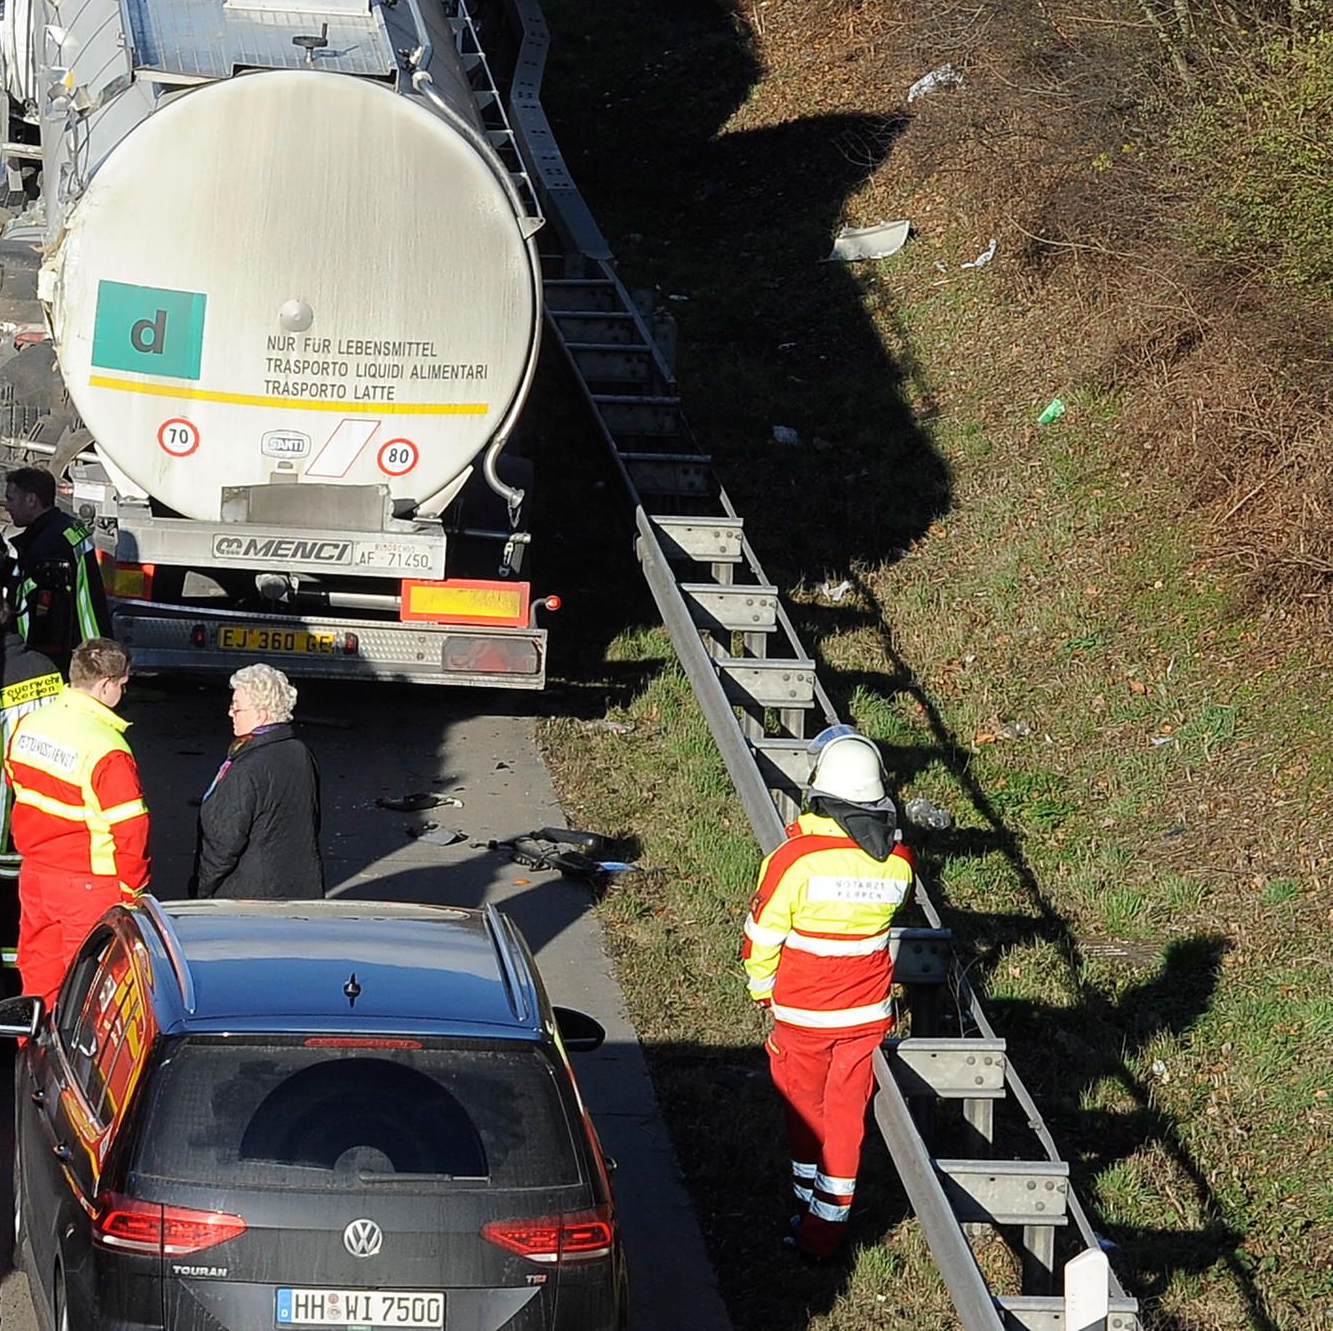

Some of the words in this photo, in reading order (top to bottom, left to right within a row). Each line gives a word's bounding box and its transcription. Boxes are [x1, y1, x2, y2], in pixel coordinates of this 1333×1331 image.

[130, 310, 168, 355] d
[267, 336, 295, 352] NUR
[338, 340, 438, 357] LEBENSMITTEL
[266, 358, 348, 377] TRASPORTO
[356, 363, 404, 379] LIQUIDI
[410, 364, 488, 380] ALIMENTARI
[264, 380, 346, 399] TRASPORTO
[354, 385, 395, 401] LATTE
[169, 428, 189, 445] 70
[388, 448, 409, 465] 80
[242, 539, 350, 562] MENCI
[359, 551, 375, 565] AF
[388, 552, 429, 568] 71450
[258, 631, 295, 650] 360
[173, 1265, 228, 1278] TOURAN
[294, 1294, 325, 1320] HH
[345, 1296, 373, 1322] WI
[381, 1297, 441, 1323] 7500
